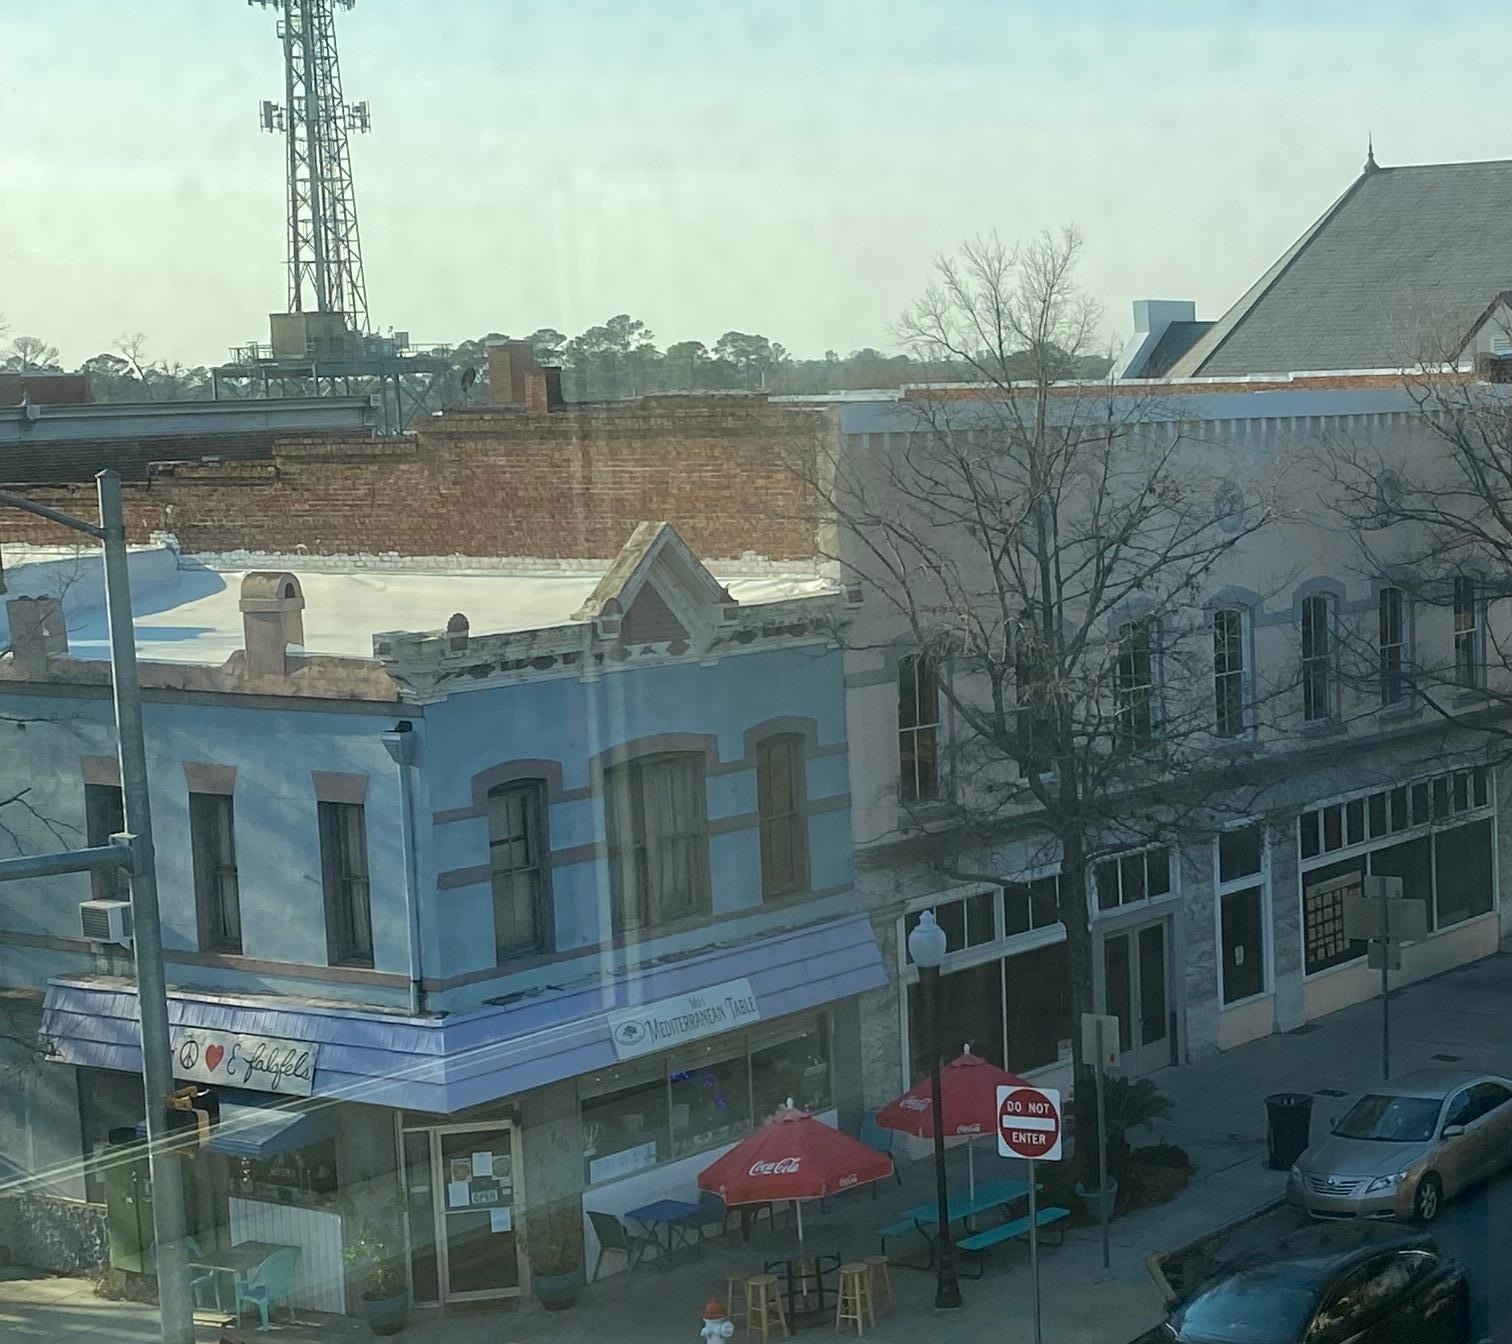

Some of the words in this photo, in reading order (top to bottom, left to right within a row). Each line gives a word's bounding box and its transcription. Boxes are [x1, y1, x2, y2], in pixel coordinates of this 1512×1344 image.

[644, 1005, 726, 1044] MEDITERRANEAN
[724, 995, 757, 1020] TABLE
[243, 1042, 311, 1090] falafels
[1006, 1100, 1022, 1113] DO
[1028, 1102, 1050, 1114] NOT
[1012, 1131, 1046, 1145] ENTER
